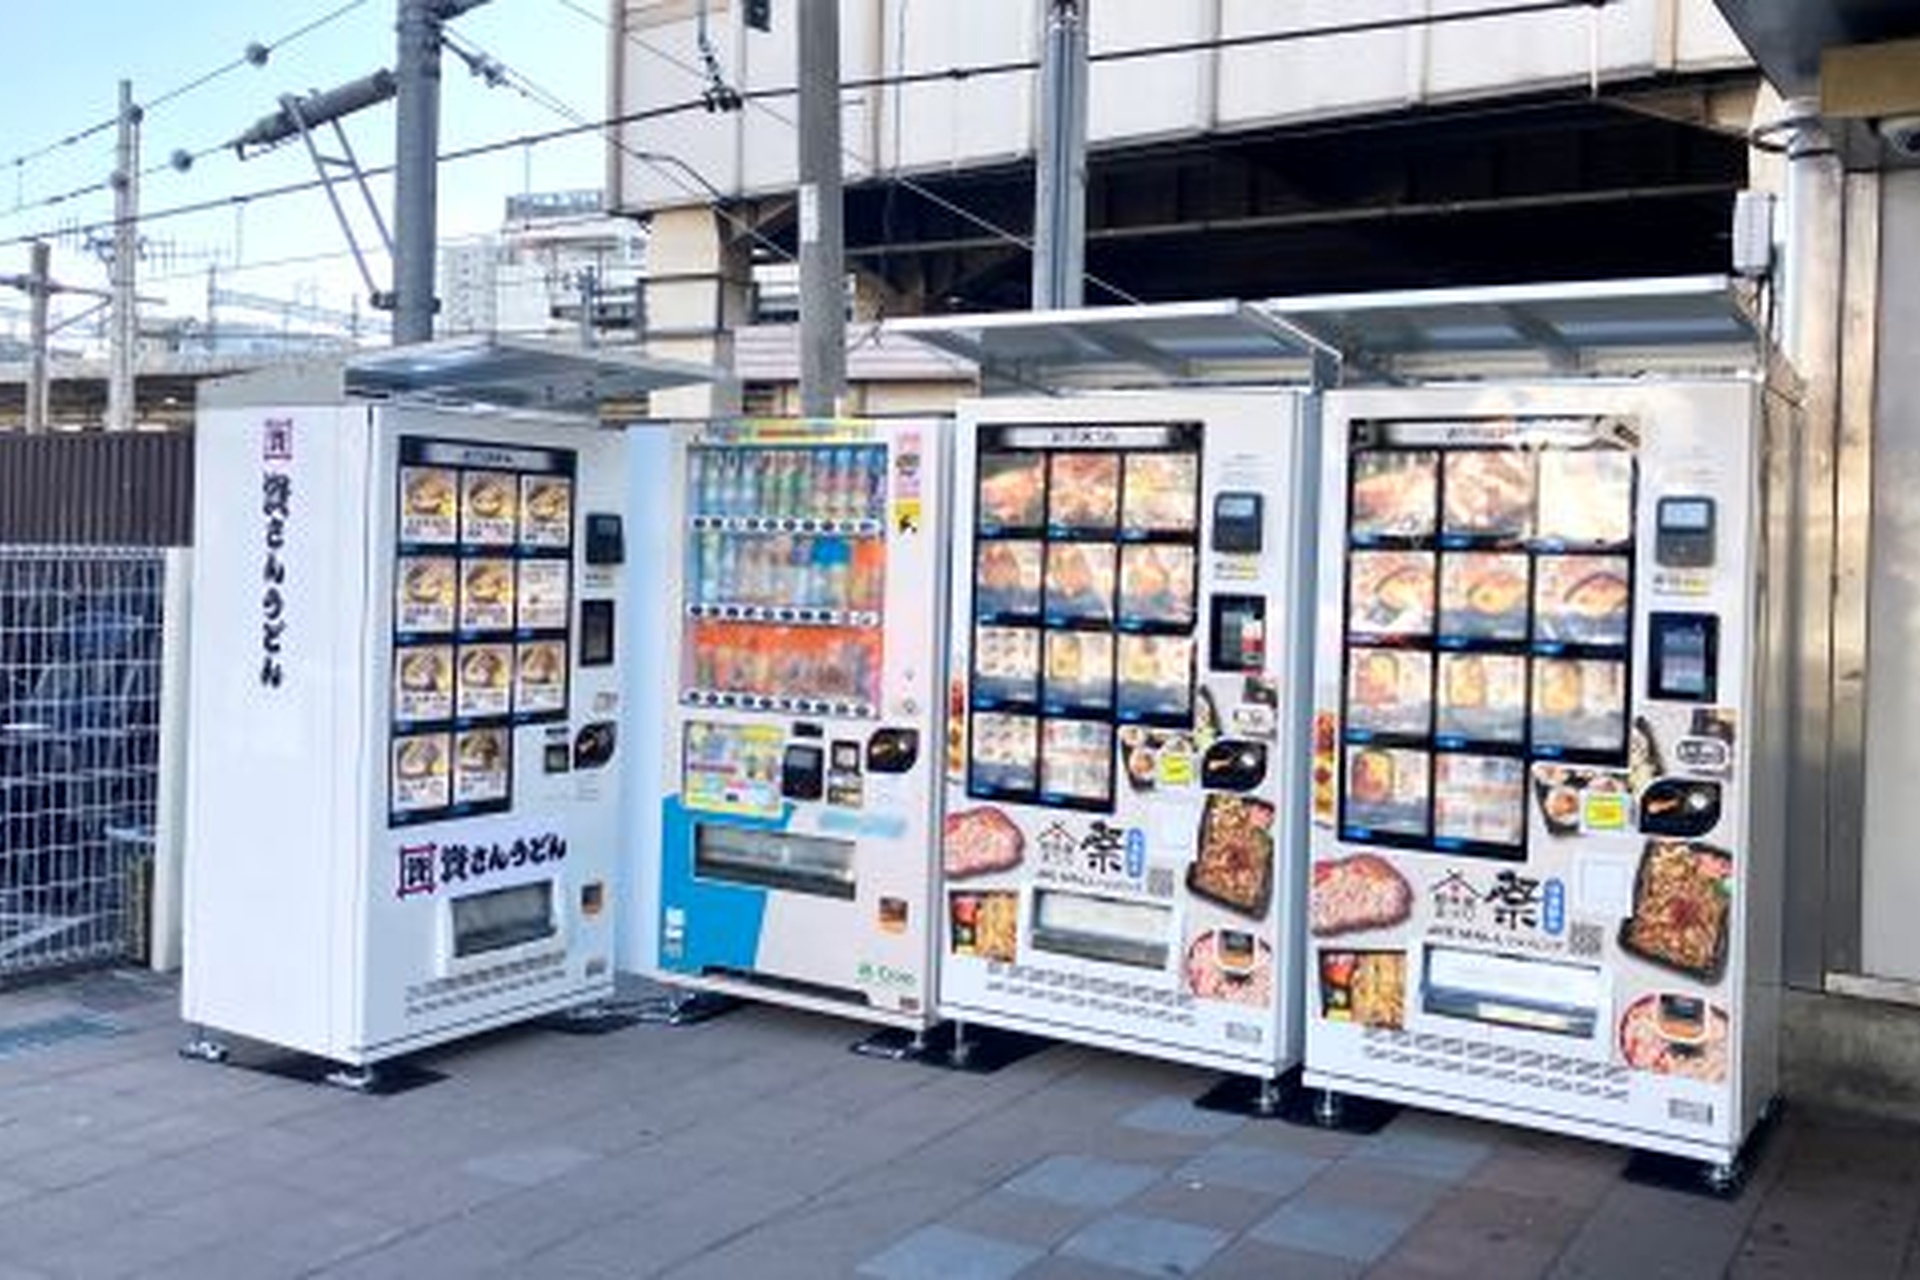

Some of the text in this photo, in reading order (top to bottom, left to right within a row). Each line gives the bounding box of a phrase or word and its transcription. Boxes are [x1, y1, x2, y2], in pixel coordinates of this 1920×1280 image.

[440, 832, 567, 883] 資さんうどん
